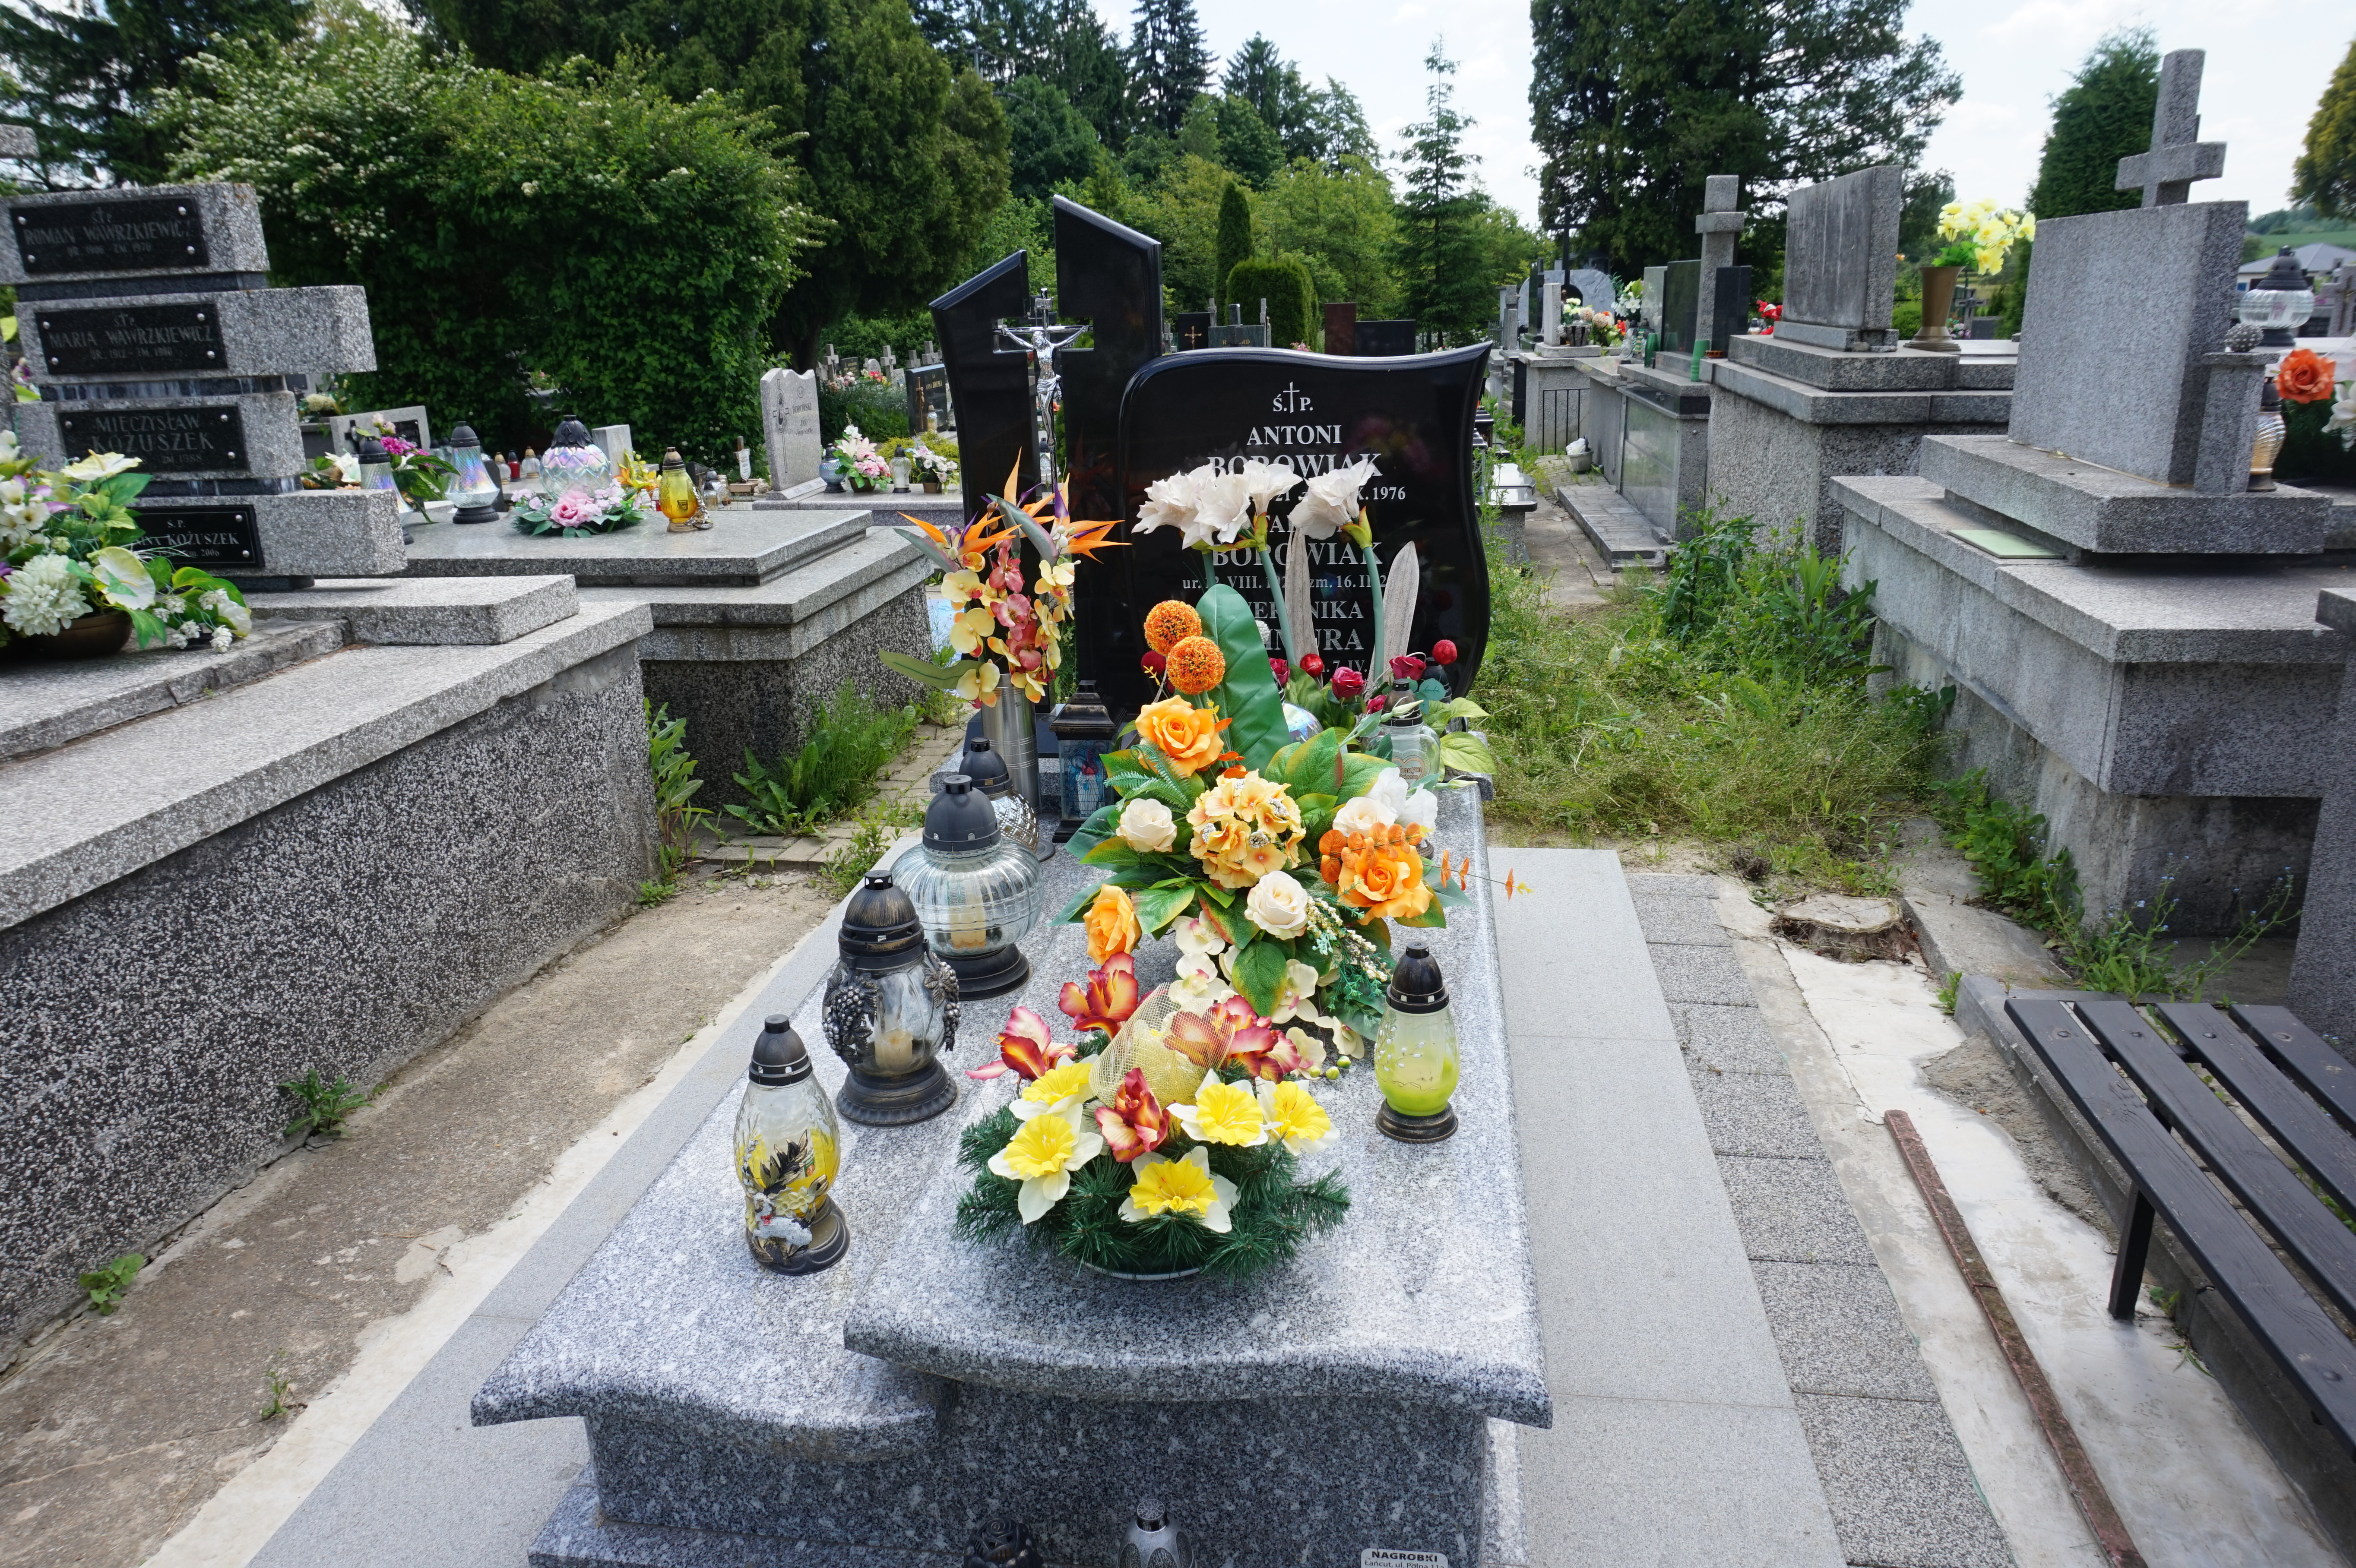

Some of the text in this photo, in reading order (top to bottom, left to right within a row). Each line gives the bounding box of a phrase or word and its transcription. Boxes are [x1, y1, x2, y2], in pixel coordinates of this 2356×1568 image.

[24, 227, 76, 245] ROMAN
[48, 325, 214, 348] MARIA WAWRZKIEWICZ
[95, 411, 200, 432] MIECZYSŁAW
[1246, 425, 1342, 445] ANTONI
[1372, 486, 1406, 500] 1976
[167, 531, 240, 545] KOŻUSZEK
[1182, 579, 1201, 589] ur.
[1227, 575, 1262, 589] VIII.
[1336, 575, 1356, 588] 16.
[1365, 1559, 1393, 1568] Łańcut,
[1372, 1551, 1438, 1562] NAGROBKI
